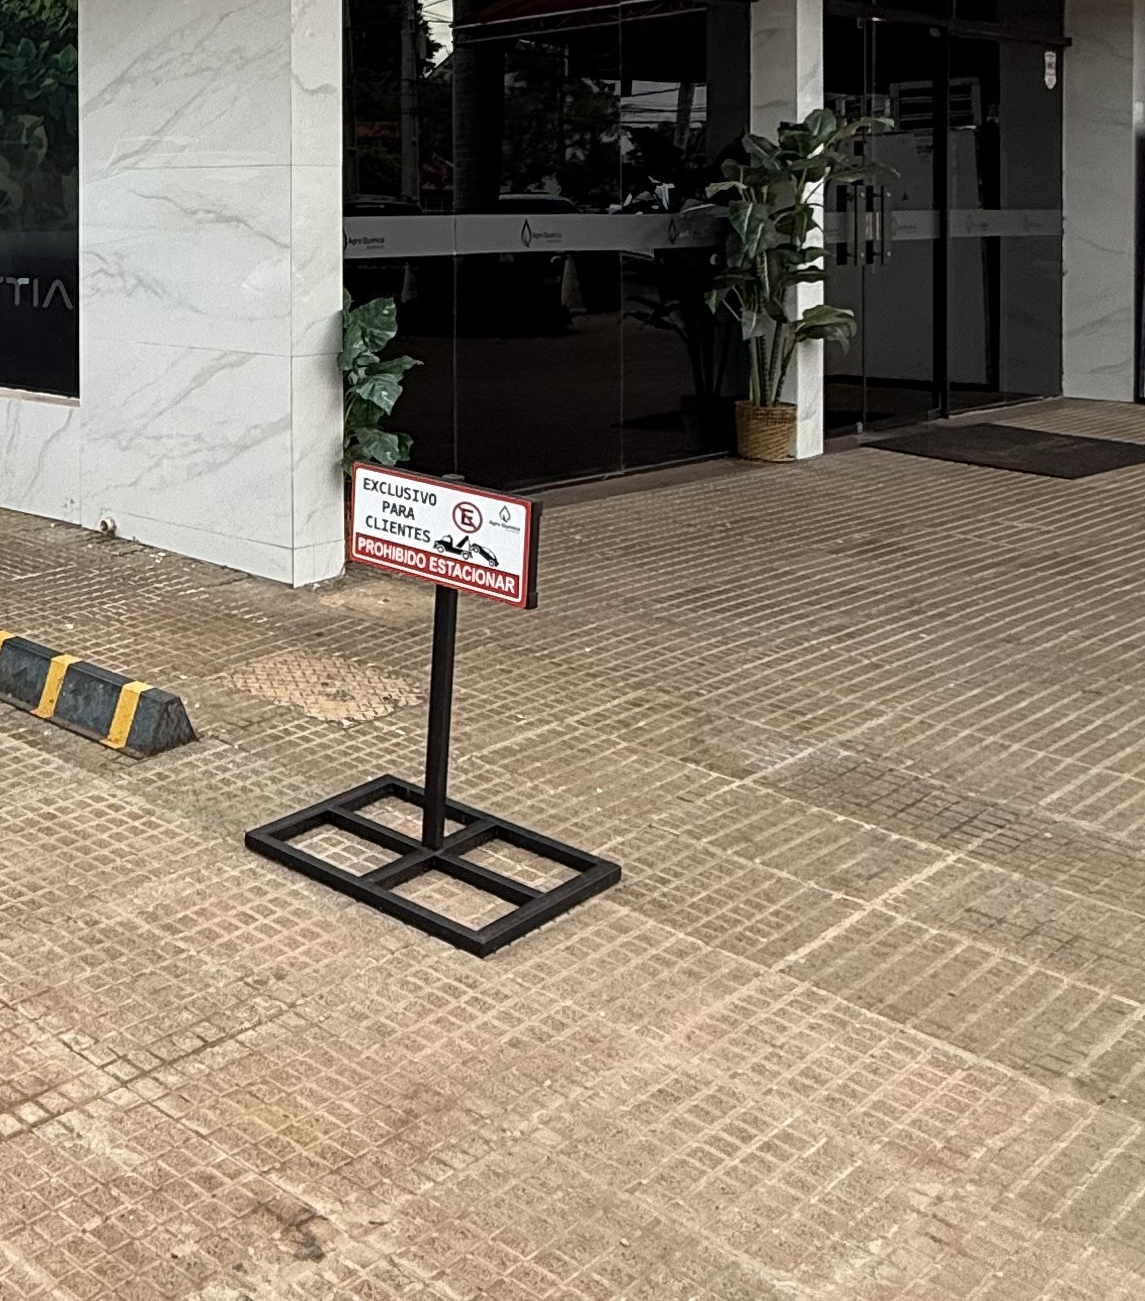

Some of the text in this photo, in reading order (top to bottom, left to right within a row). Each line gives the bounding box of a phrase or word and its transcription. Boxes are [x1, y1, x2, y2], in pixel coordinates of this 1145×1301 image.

[363, 477, 437, 507] EXCLUSIVO
[382, 500, 415, 521] PARA
[365, 515, 431, 544] CLIENTES
[358, 537, 516, 594] PROHIBIDO ESTACIONAR
